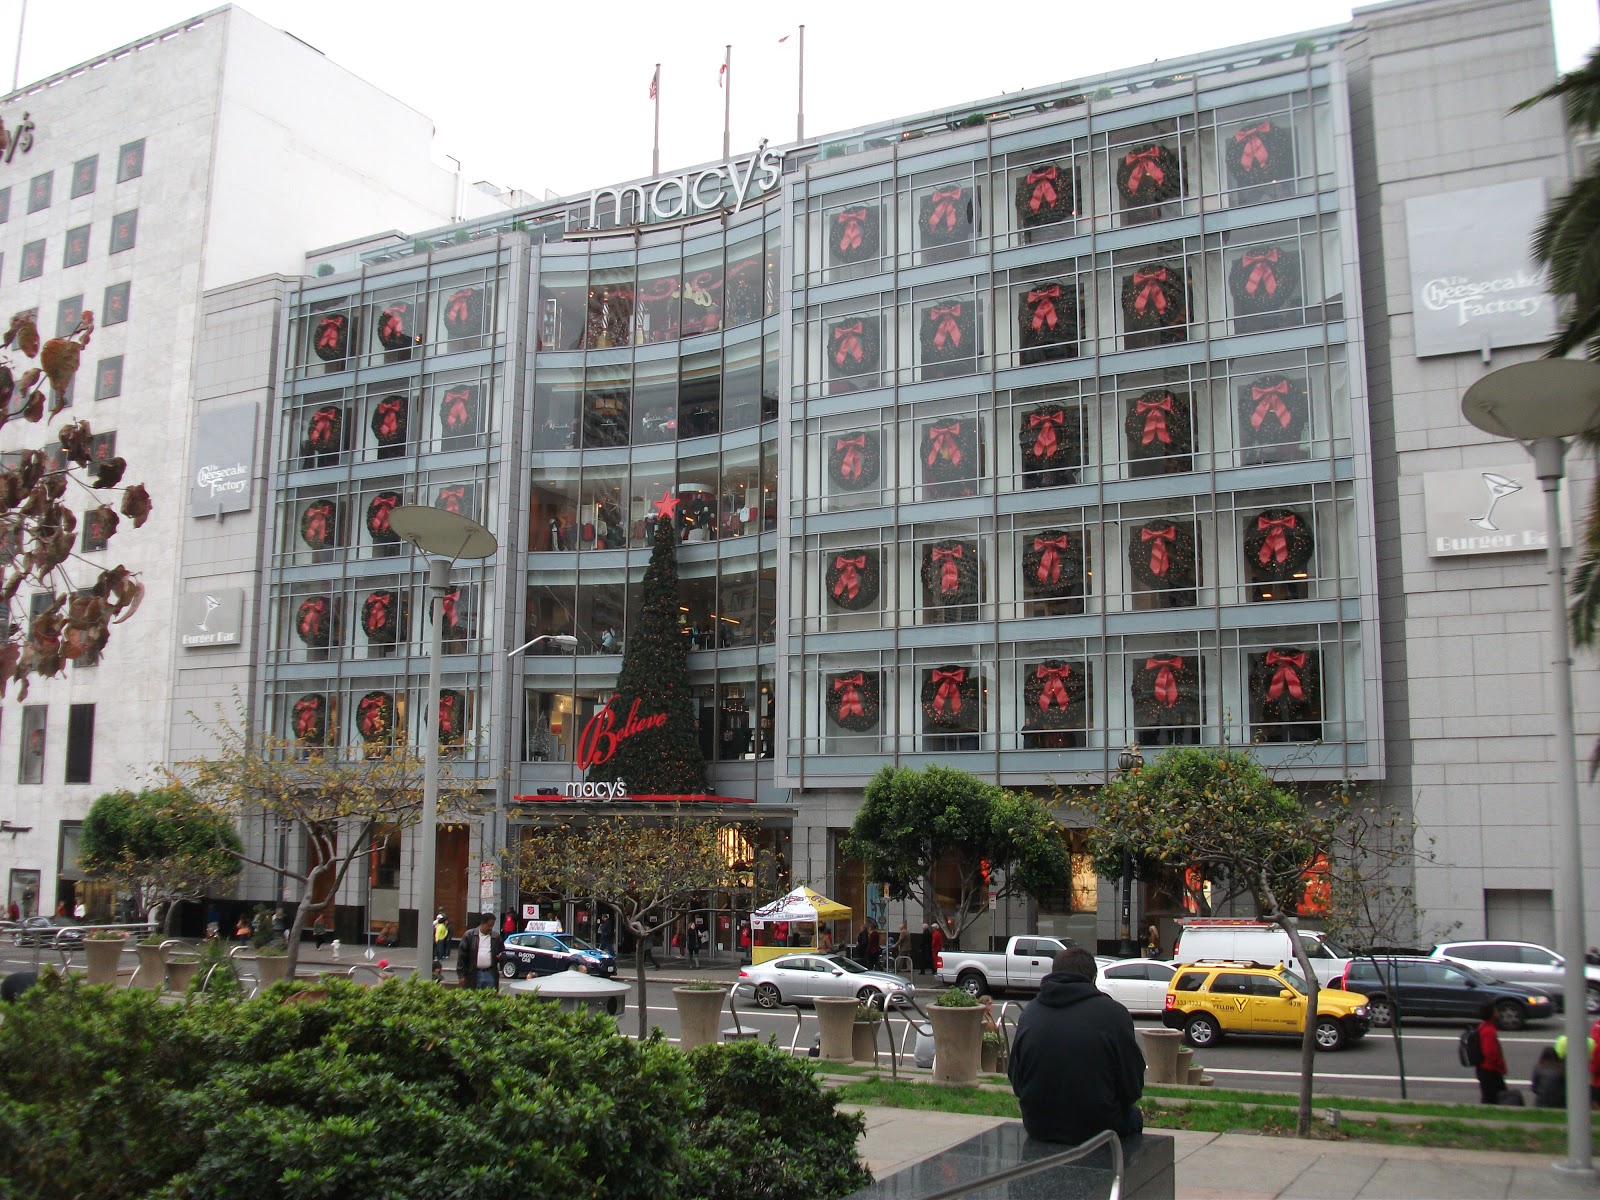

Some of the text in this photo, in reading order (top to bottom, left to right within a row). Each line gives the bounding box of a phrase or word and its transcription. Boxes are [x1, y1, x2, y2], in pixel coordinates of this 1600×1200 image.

[588, 137, 785, 228] macy's
[1423, 268, 1545, 311] Cheesecake
[1446, 295, 1546, 328] Factory
[197, 462, 247, 487] Cheesecake
[207, 478, 246, 498] Factory
[1436, 529, 1558, 552] Burger Ba
[182, 632, 236, 645] Burger Bar
[577, 694, 668, 771] Believe
[565, 776, 627, 801] macy's
[1212, 1003, 1236, 1011] YELLOW
